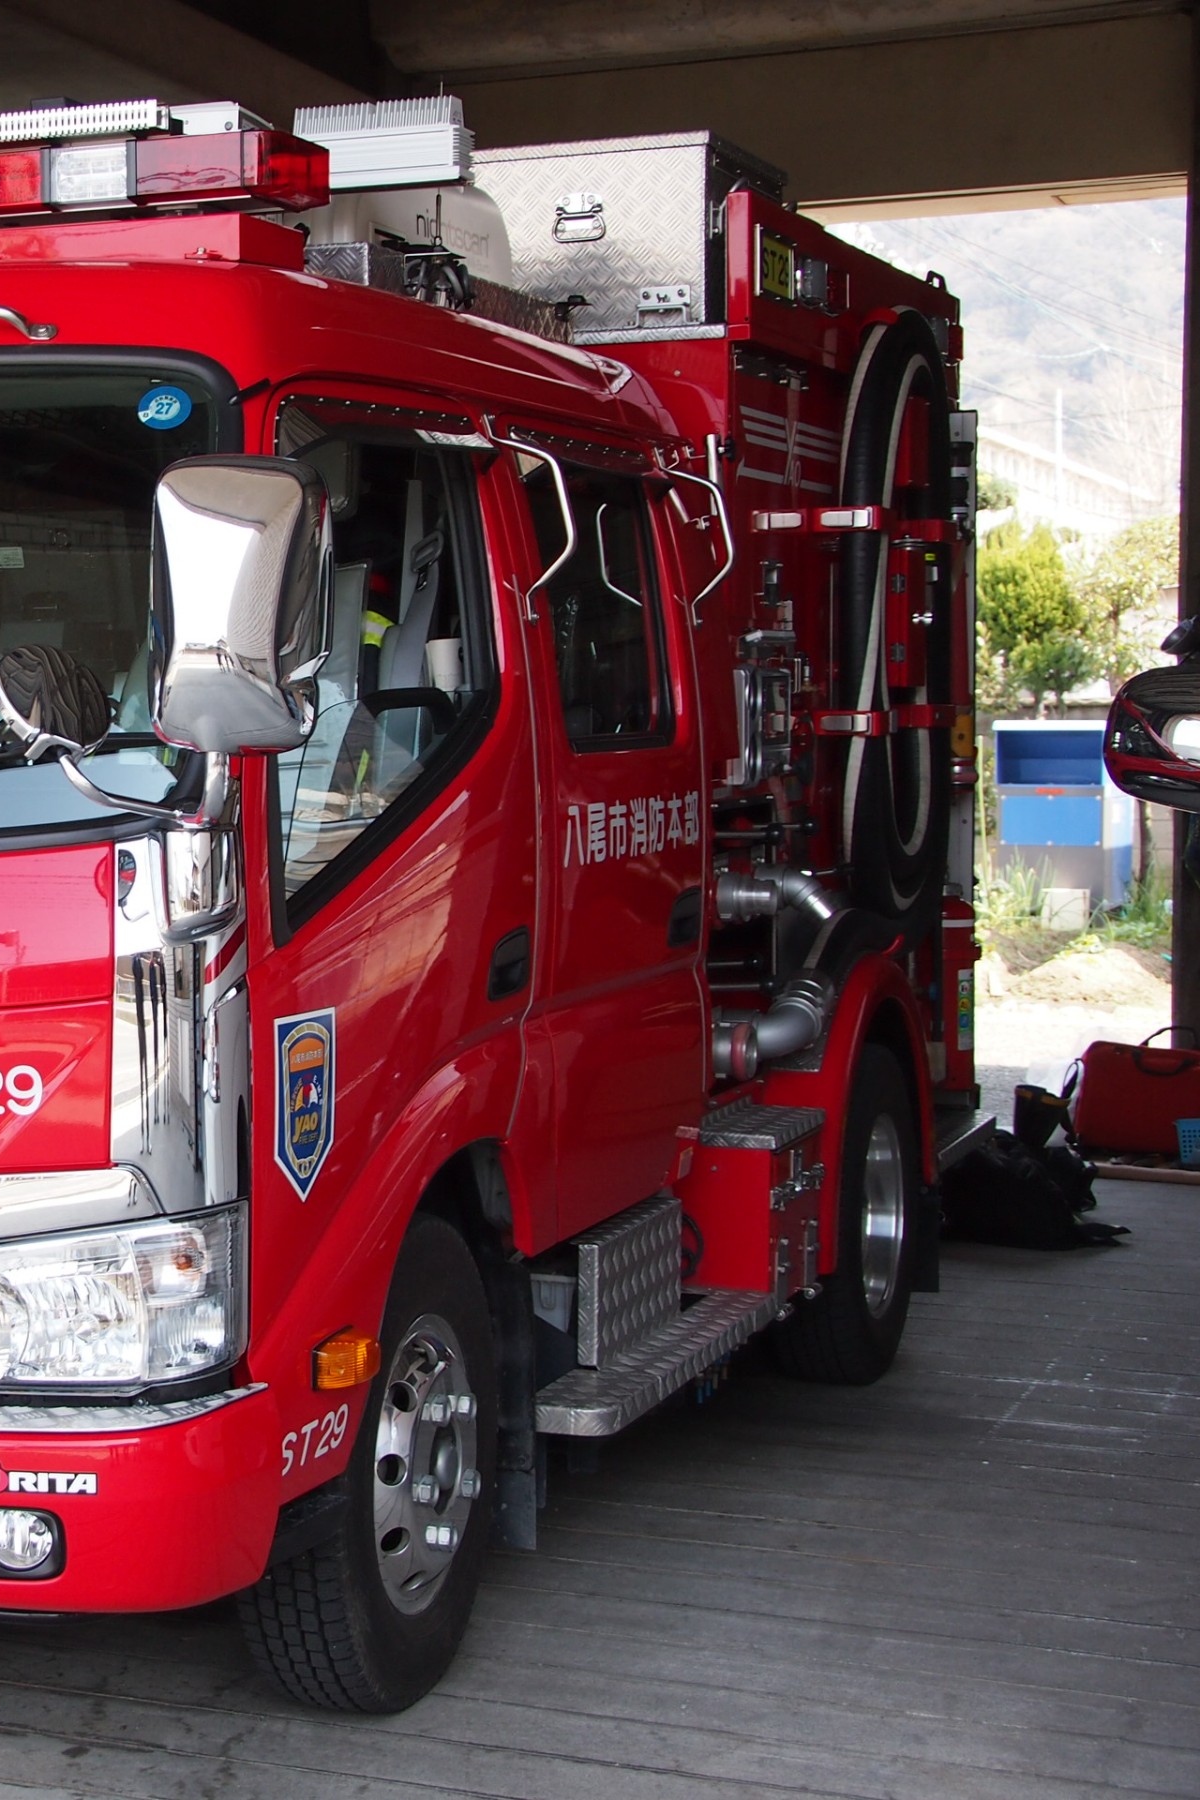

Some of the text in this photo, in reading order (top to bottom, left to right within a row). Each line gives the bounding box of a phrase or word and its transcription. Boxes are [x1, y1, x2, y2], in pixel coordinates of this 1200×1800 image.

[155, 402, 173, 415] 27
[563, 790, 700, 868] 八尾市消防本部
